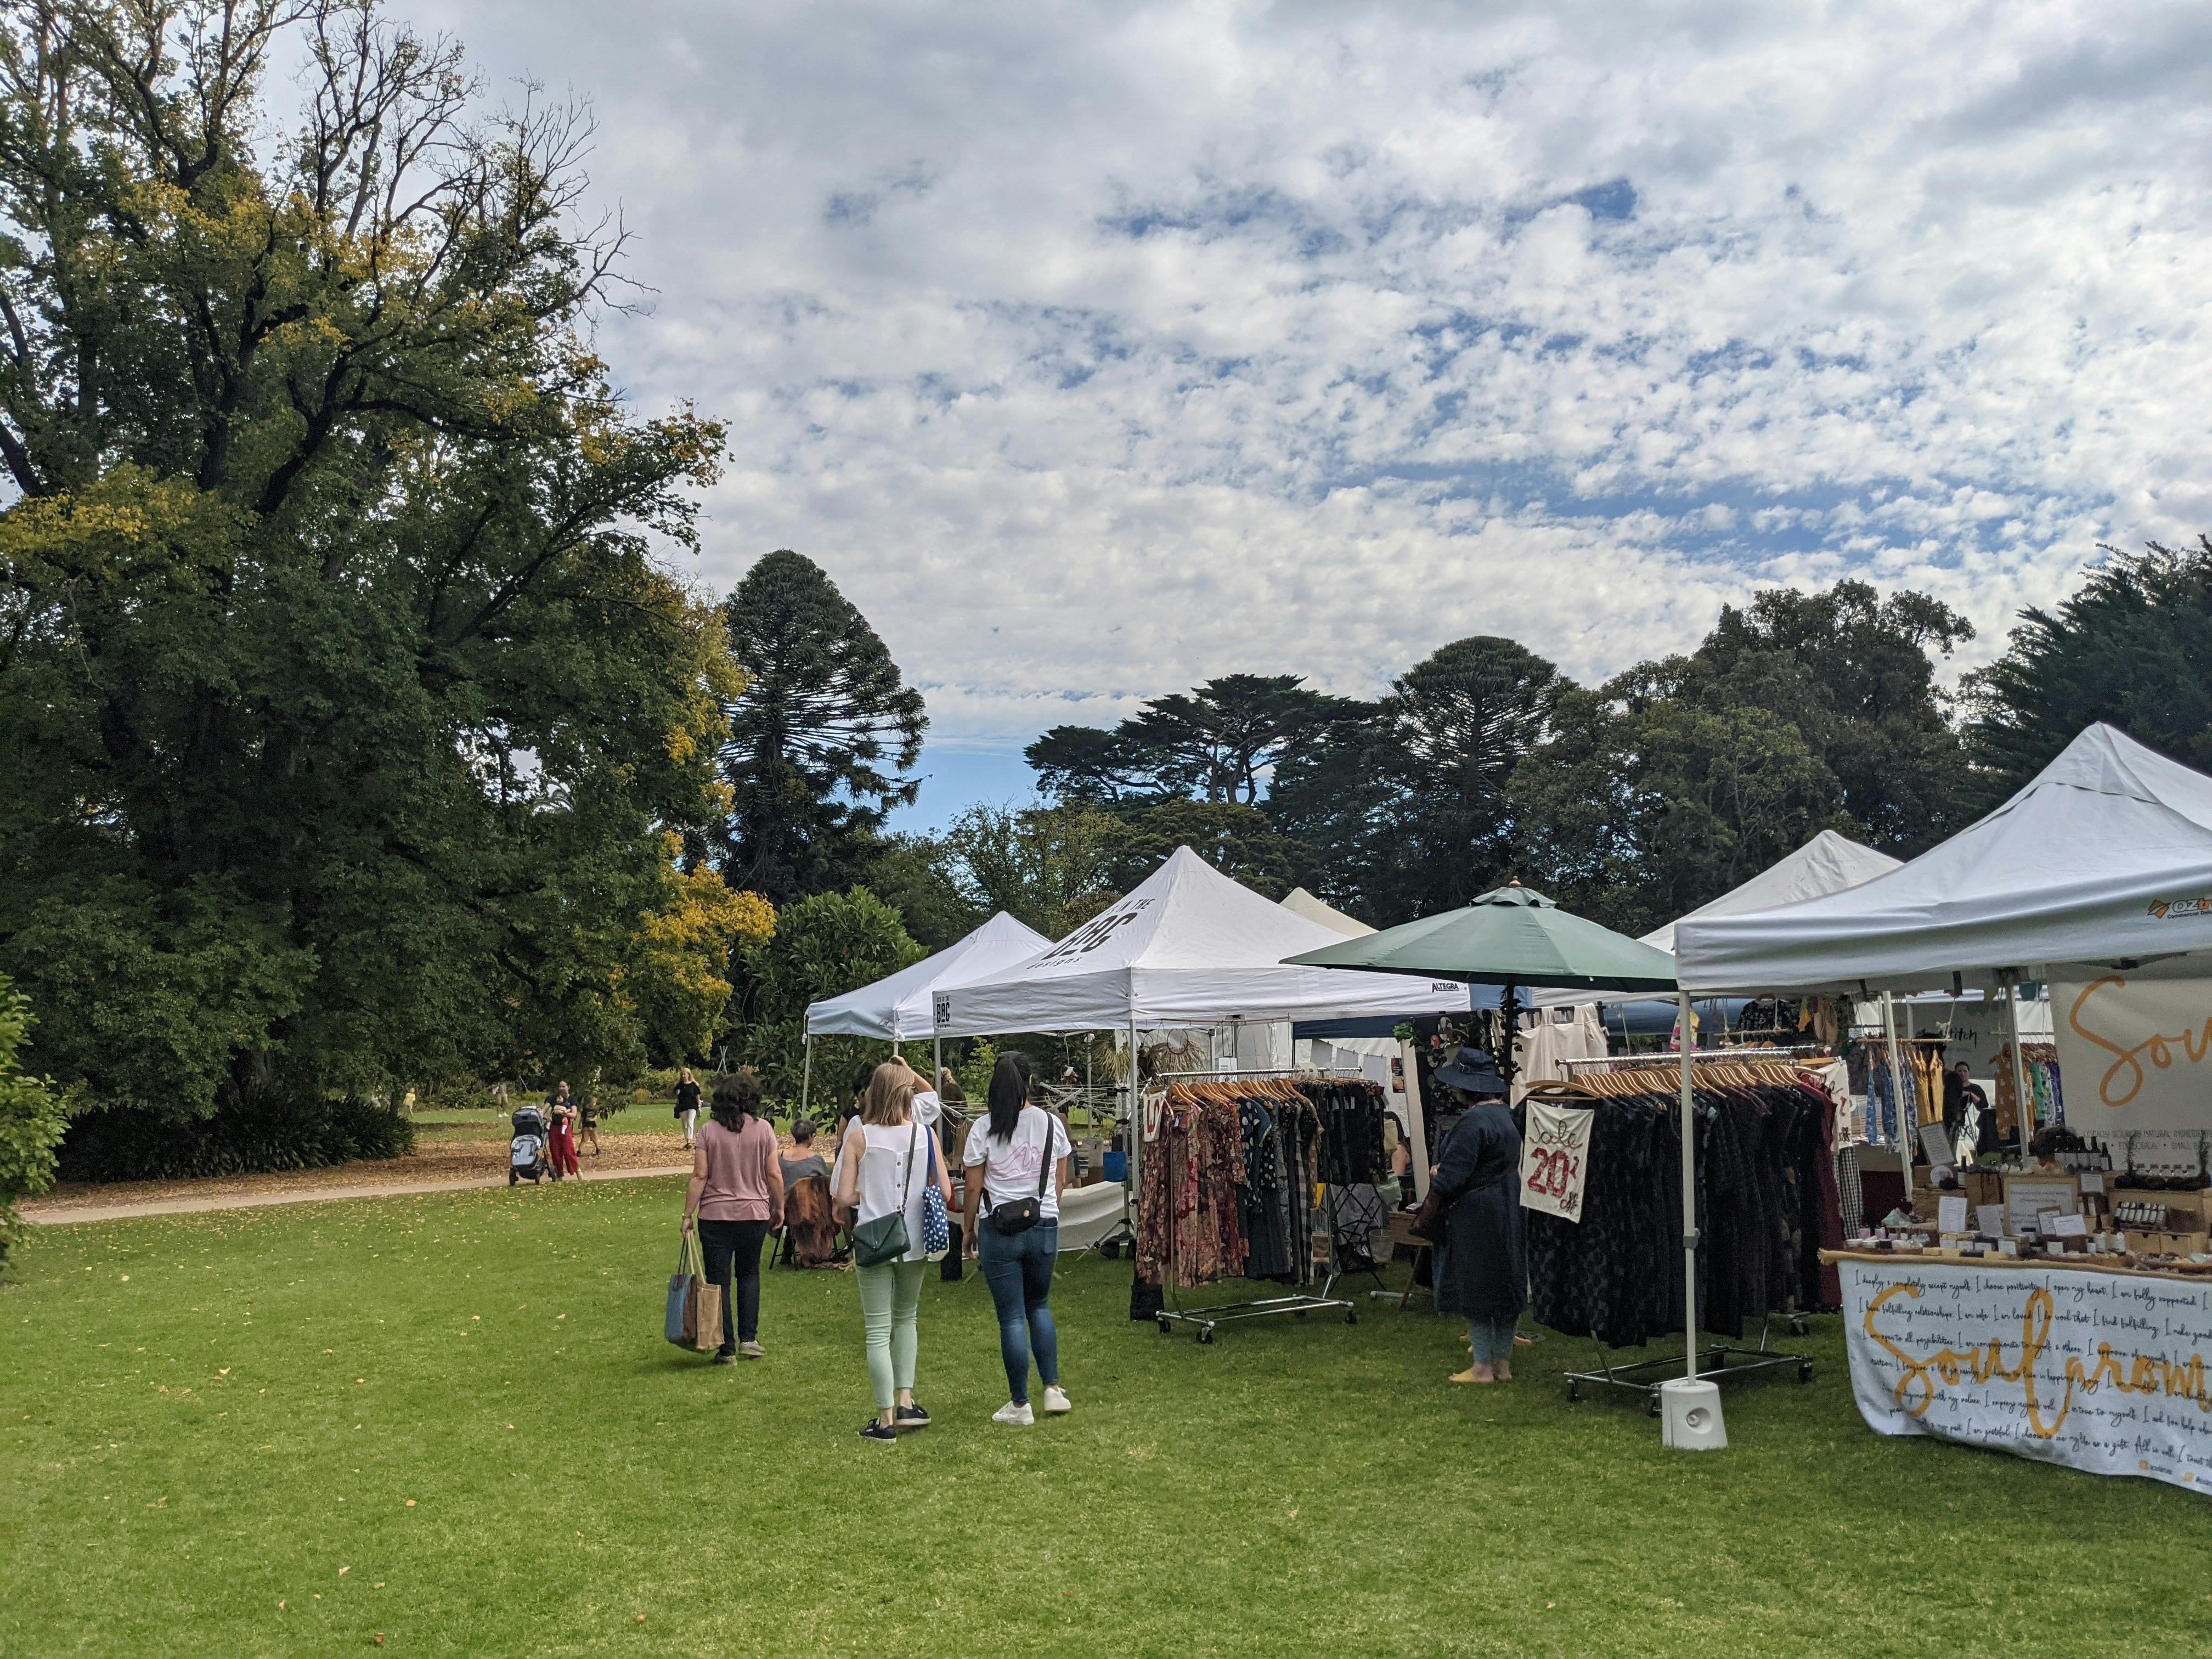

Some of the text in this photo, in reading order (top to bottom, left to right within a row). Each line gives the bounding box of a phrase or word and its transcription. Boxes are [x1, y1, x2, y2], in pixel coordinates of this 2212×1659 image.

[1130, 898, 1155, 910] THE
[1431, 983, 1459, 993] ALTEGRA
[936, 1002, 950, 1024] BAG
[2069, 974, 2212, 1107] Sou
[1528, 1116, 1583, 1149] Sale
[1855, 1269, 1860, 1285] I
[1976, 1276, 1981, 1293] I
[2046, 1275, 2051, 1293] I
[2112, 1280, 2118, 1299] I
[2203, 1291, 2209, 1310] I
[1859, 1296, 1864, 1313] I
[1957, 1303, 1962, 1321] I
[1993, 1304, 1999, 1322] I
[2037, 1305, 2042, 1323] I
[2093, 1308, 2099, 1327] I
[2165, 1318, 2170, 1336] I
[1863, 1323, 1867, 1340] I
[1958, 1331, 1963, 1348] I
[2087, 1338, 2094, 1356] I
[1985, 1390, 1990, 1407] I
[2142, 1406, 2149, 1423] I
[1966, 1418, 1972, 1436] I
[2014, 1423, 2020, 1440] I
